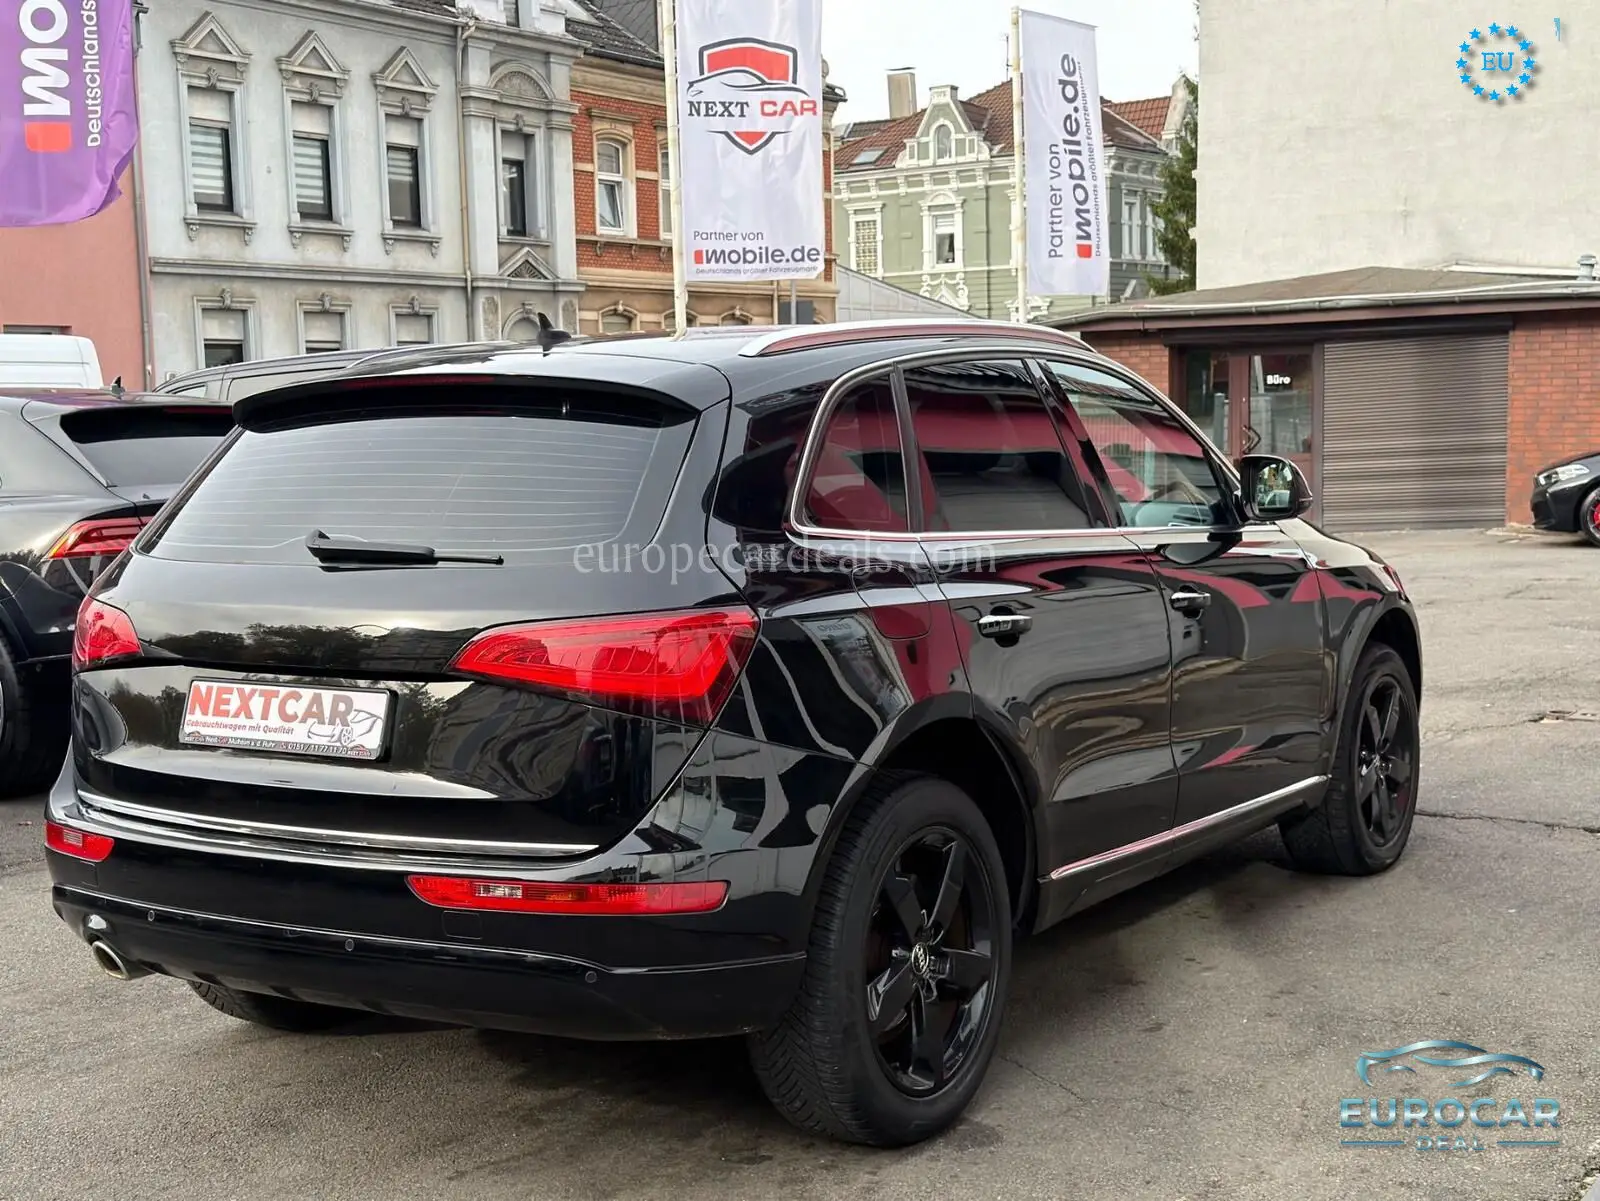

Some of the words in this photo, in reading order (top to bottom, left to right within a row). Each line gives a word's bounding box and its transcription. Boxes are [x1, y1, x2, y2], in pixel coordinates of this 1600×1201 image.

[80, 0, 101, 147] Deutschlands
[687, 101, 750, 118] NEXT
[760, 99, 818, 117] CAR
[1058, 53, 1092, 241] mobile.de
[1048, 143, 1062, 180] von
[693, 230, 738, 241] Partner
[741, 232, 764, 241] von
[1048, 184, 1064, 259] Partner
[705, 245, 821, 265] mobile.de
[1266, 374, 1291, 385] Büro
[187, 684, 354, 727] NEXTCAR
[186, 719, 247, 732] Gebrauchtwagen
[248, 723, 262, 732] mit
[263, 724, 295, 736] Qualität
